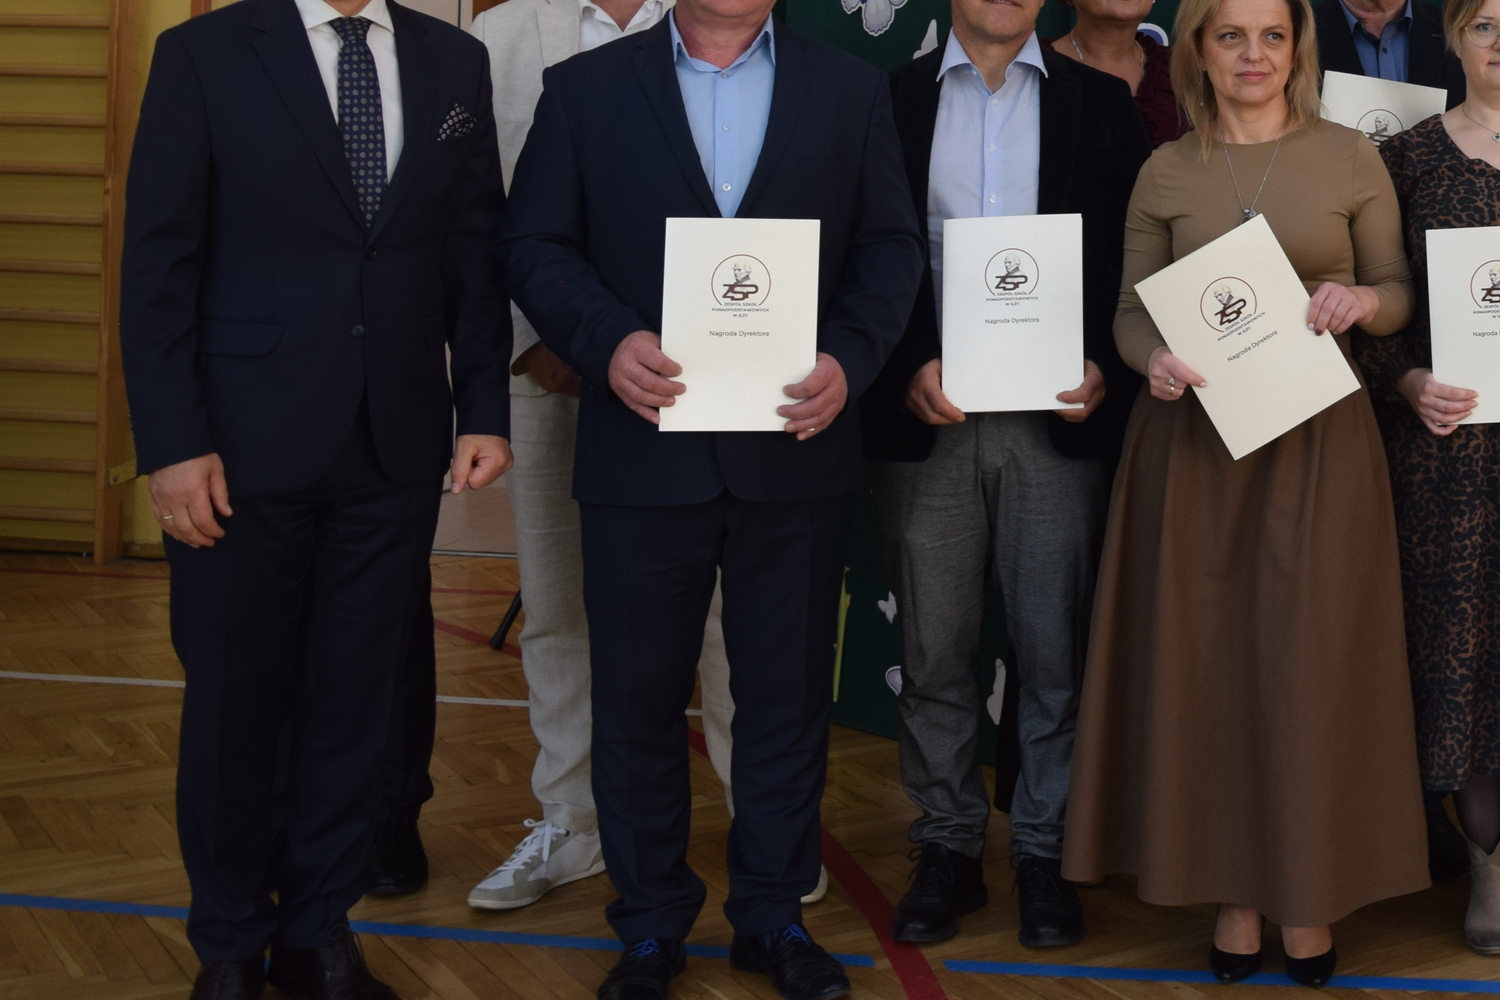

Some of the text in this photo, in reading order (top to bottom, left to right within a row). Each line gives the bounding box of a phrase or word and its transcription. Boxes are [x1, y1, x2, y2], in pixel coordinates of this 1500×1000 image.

[722, 284, 759, 301] ZSP
[995, 275, 1028, 291] ZSP
[1214, 298, 1246, 326] ZSP
[1227, 330, 1278, 362] Nagroda Dyrektora
